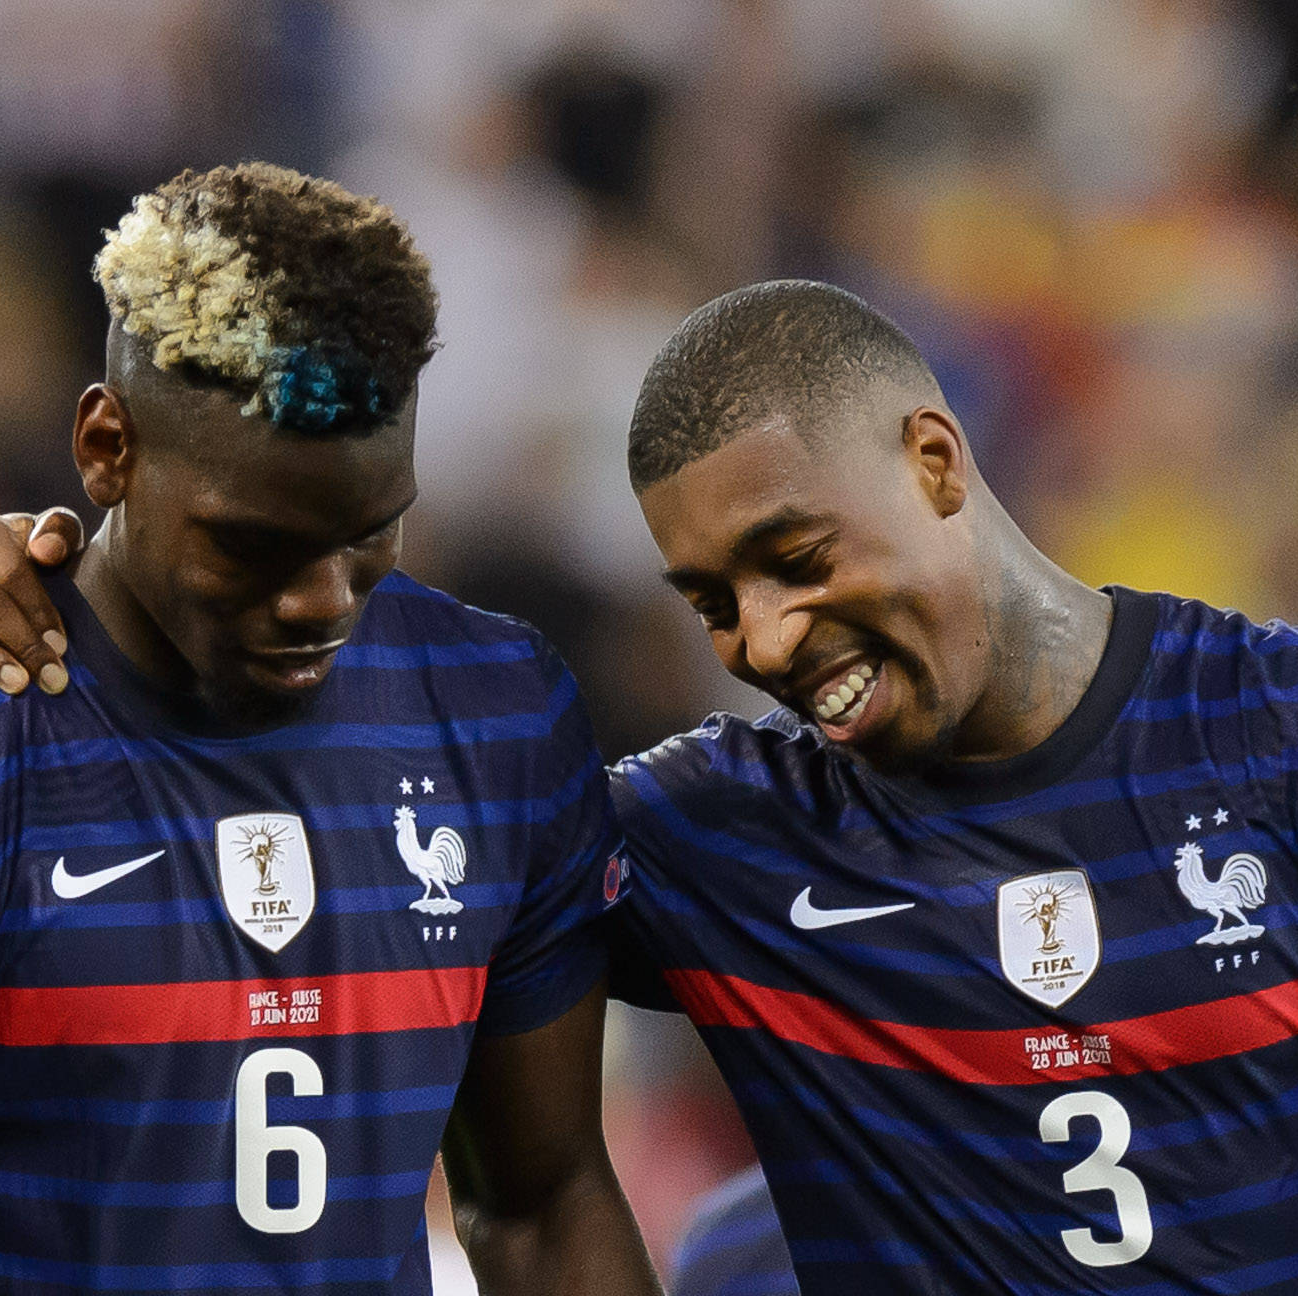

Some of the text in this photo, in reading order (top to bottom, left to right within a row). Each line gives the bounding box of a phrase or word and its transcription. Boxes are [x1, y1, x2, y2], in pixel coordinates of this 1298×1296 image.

[251, 900, 290, 917] FIFA
[1032, 956, 1073, 975] FIFA
[1214, 950, 1260, 973] FFF
[1043, 981, 1065, 990] 2018
[290, 1006, 319, 1023] 2021
[1025, 1034, 1069, 1053] FRANCE
[1031, 1053, 1050, 1070] 28
[1054, 1050, 1079, 1068] JUIN
[235, 1047, 327, 1234] 6
[1038, 1090, 1154, 1267] 3
